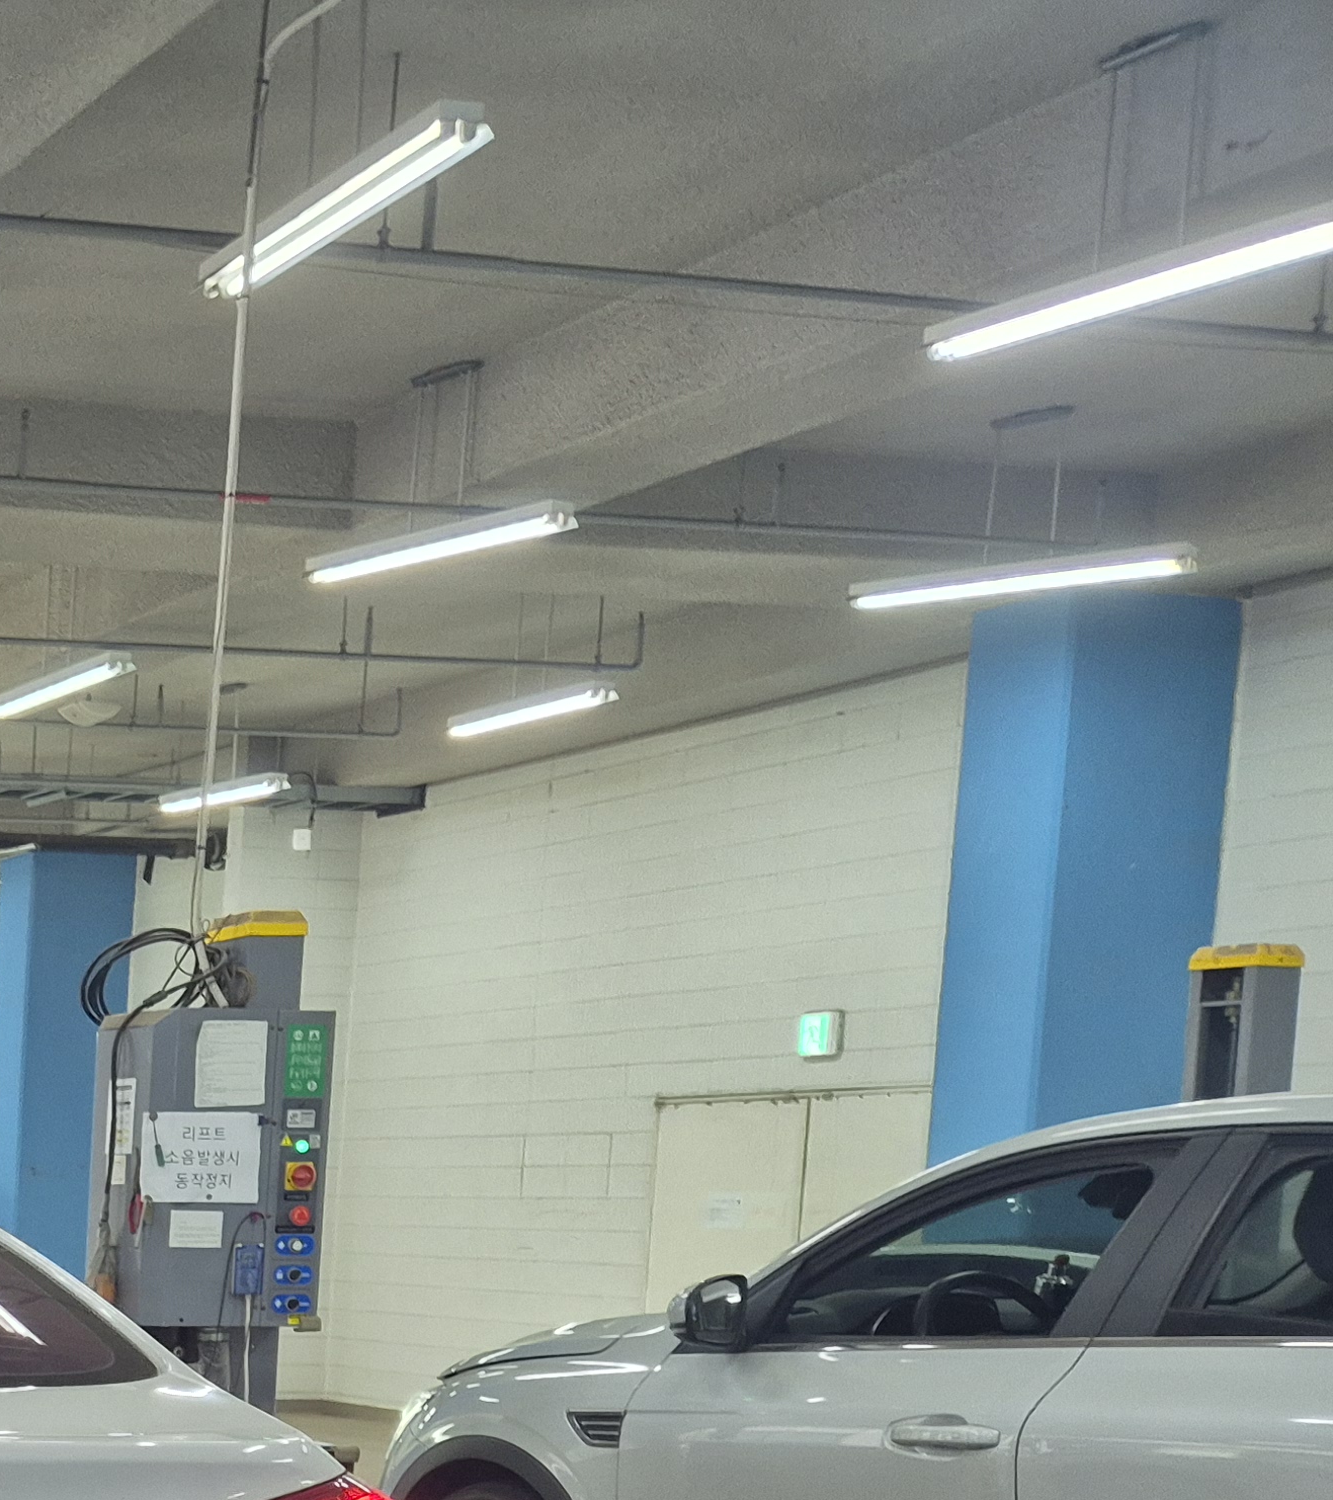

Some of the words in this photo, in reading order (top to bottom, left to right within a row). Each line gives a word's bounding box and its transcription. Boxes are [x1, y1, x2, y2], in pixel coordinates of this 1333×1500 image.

[182, 1126, 226, 1142] 리프트
[164, 1148, 240, 1167] 소음발생시
[174, 1172, 232, 1190] 동작정지
